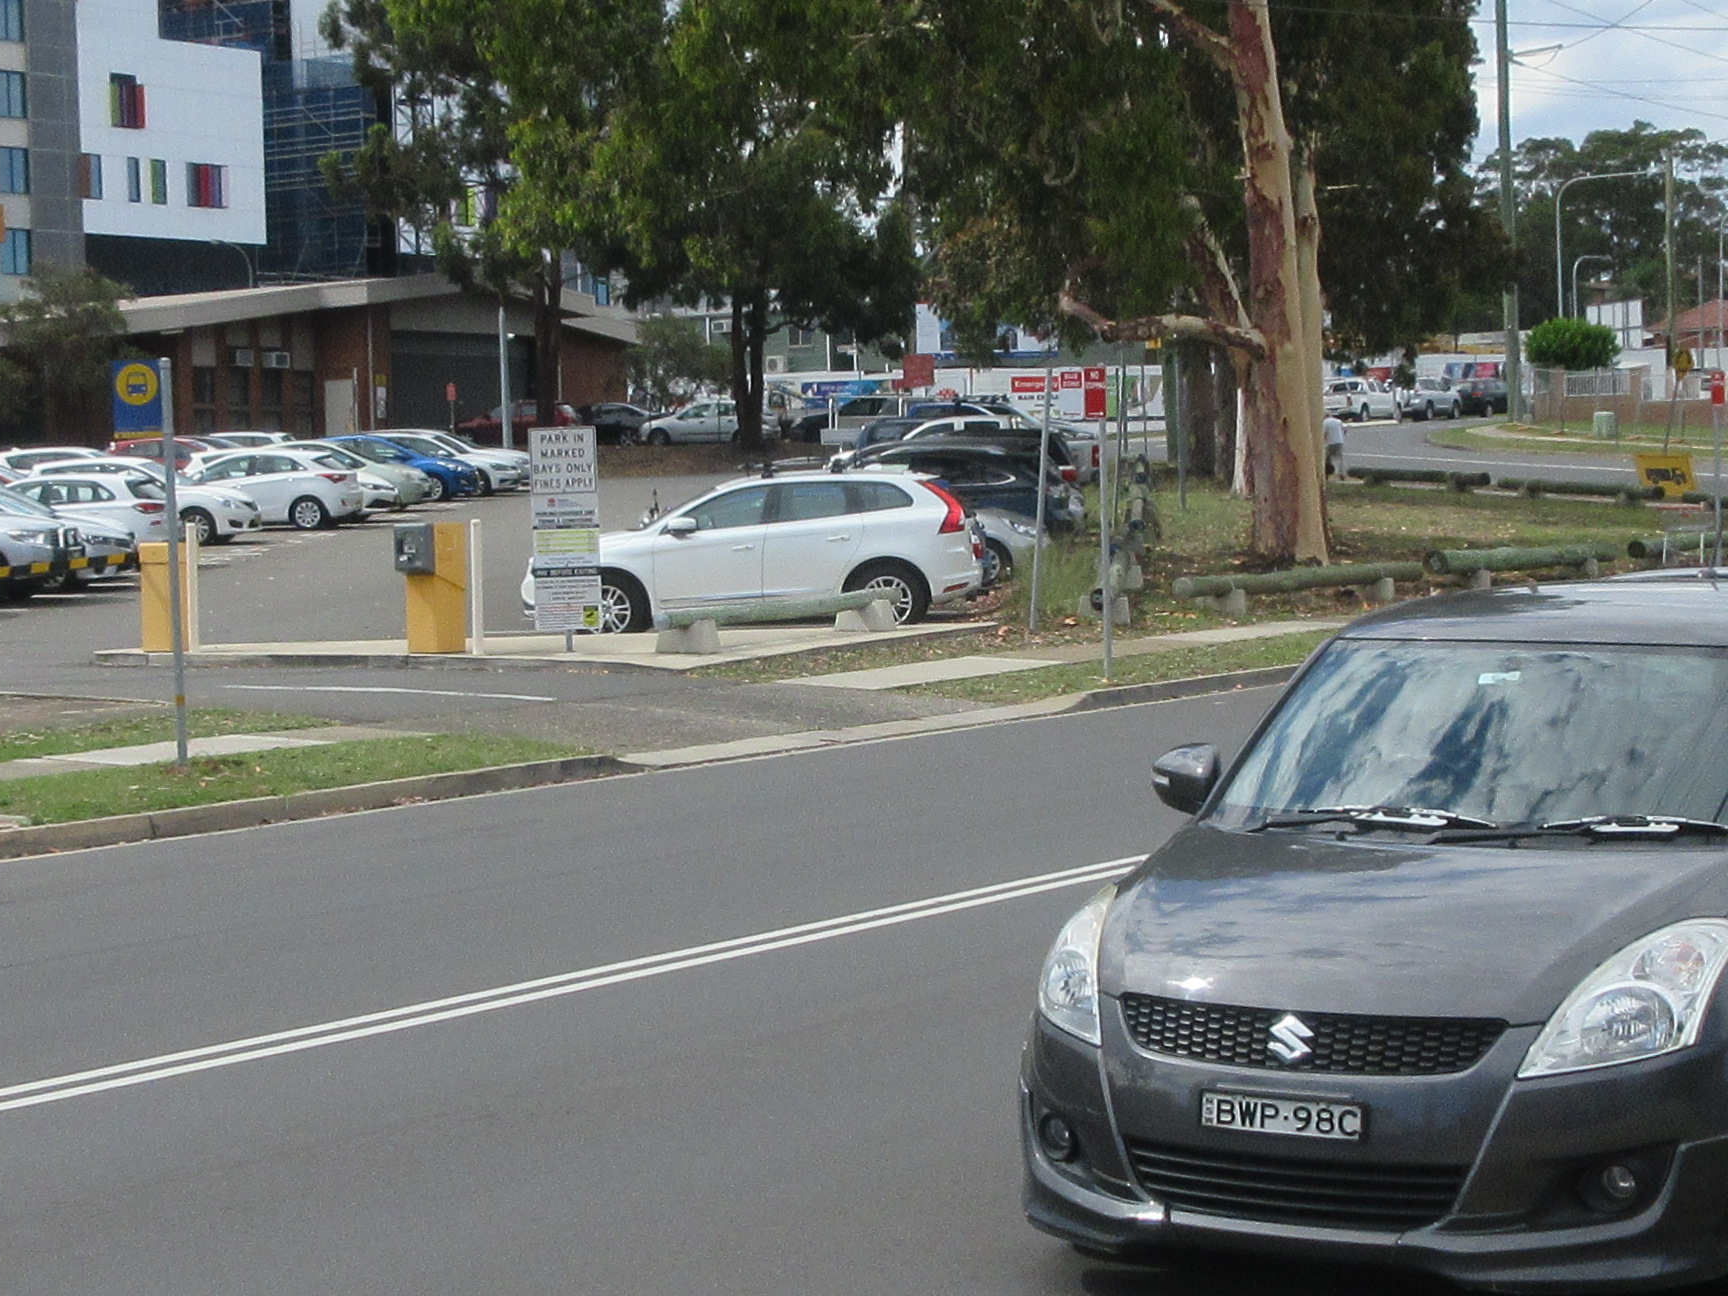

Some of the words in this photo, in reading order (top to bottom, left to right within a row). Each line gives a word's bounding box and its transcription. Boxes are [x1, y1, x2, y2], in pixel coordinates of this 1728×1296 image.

[1090, 371, 1100, 381] NO
[1015, 381, 1059, 391] Emergey
[540, 434, 569, 444] PARK
[573, 433, 585, 443] IN
[540, 447, 585, 459] MARKED
[533, 464, 562, 475] BAYS
[566, 463, 593, 474] ONLY
[534, 479, 562, 490] FINES
[565, 478, 594, 489] APPLY
